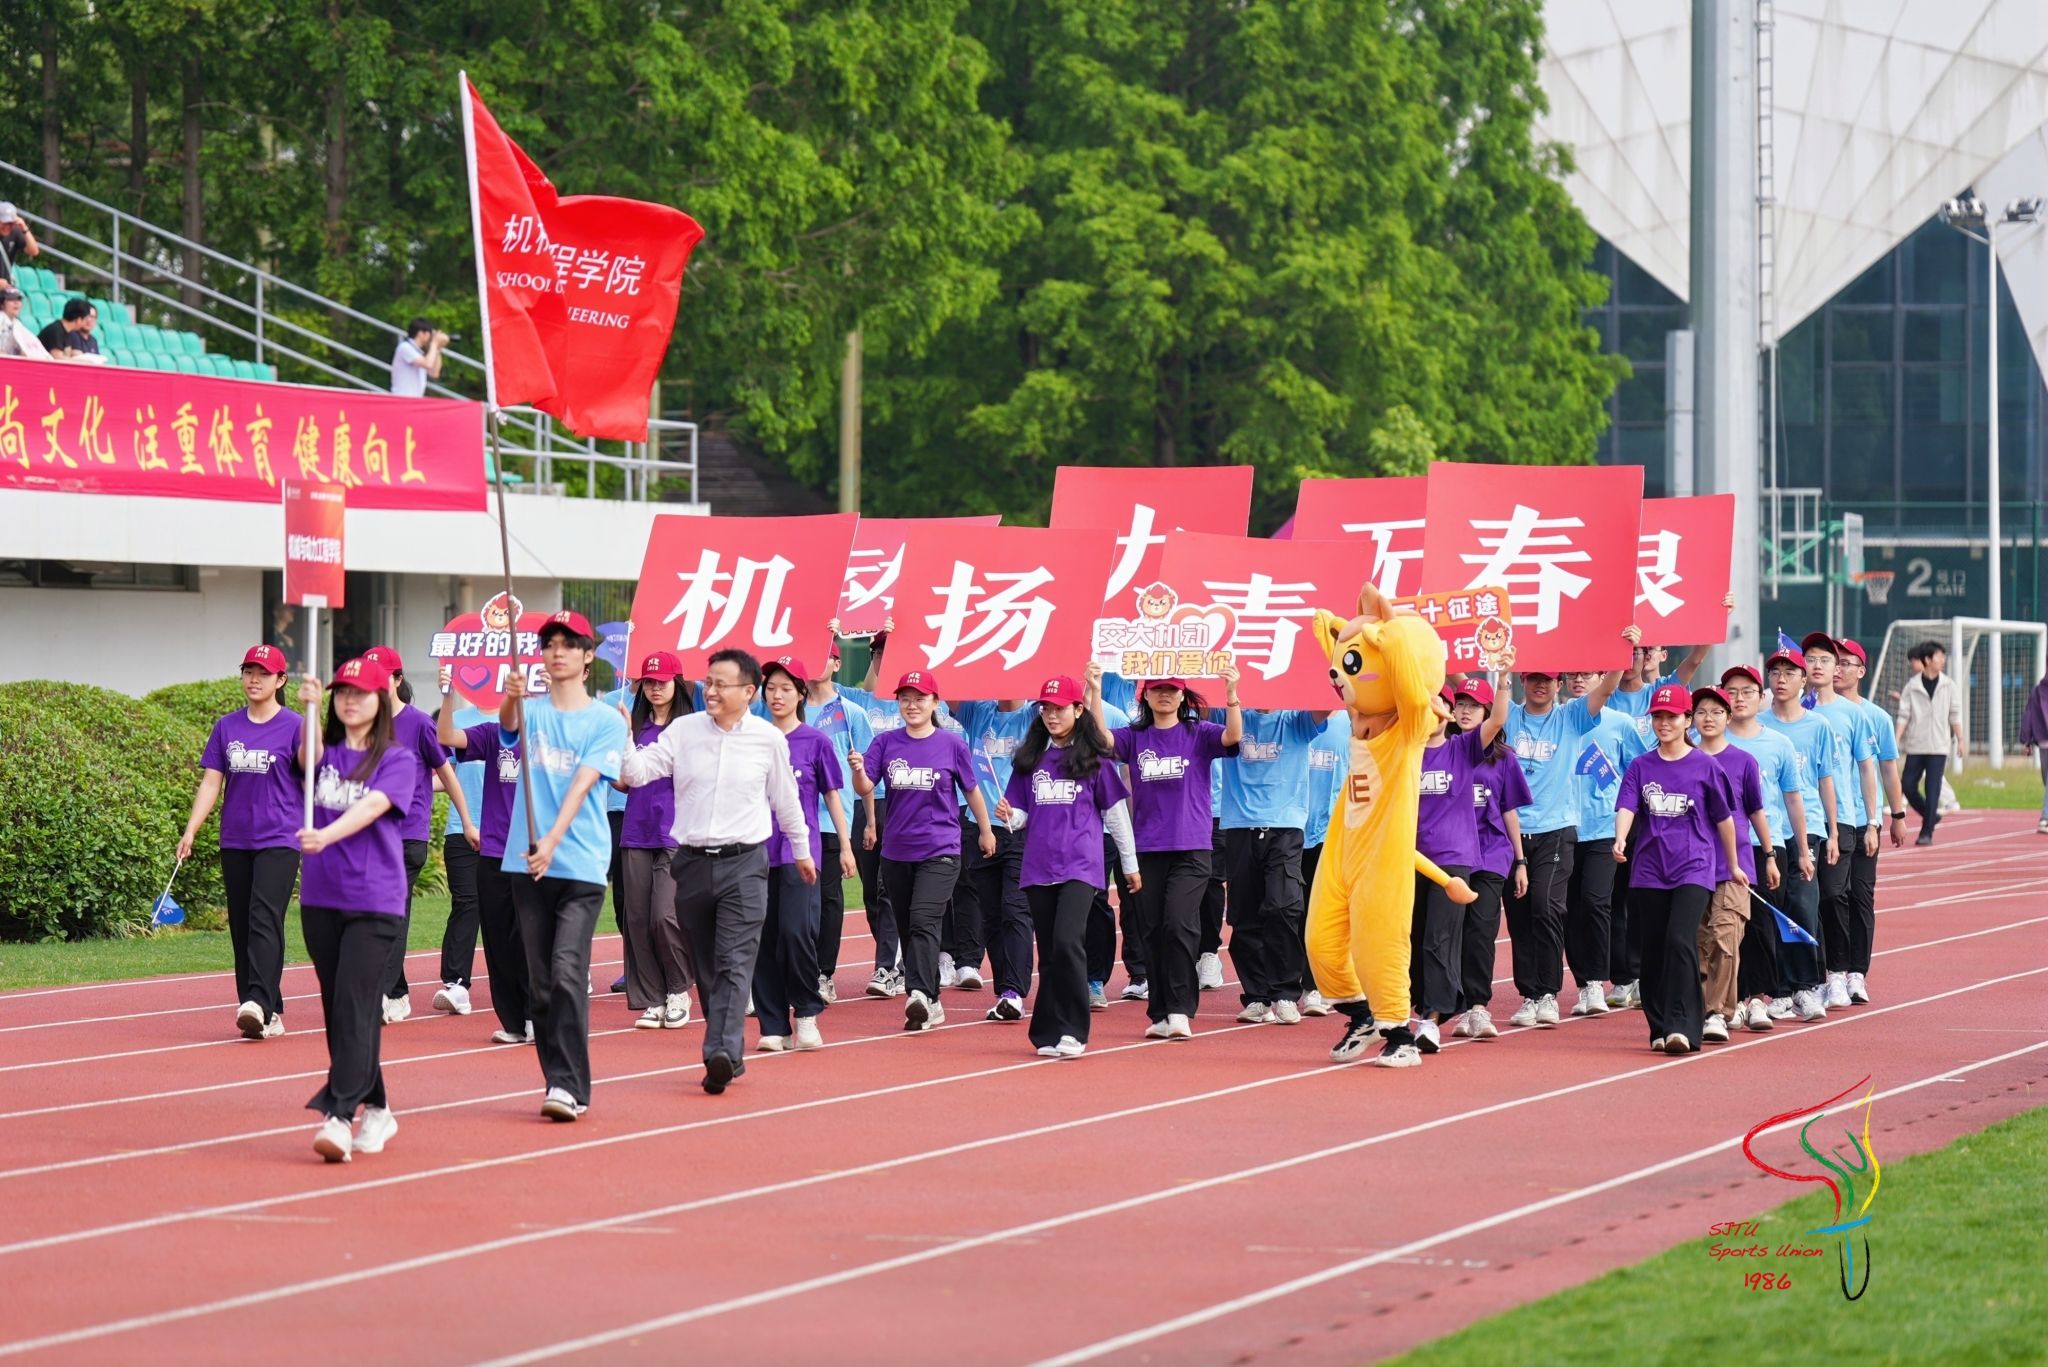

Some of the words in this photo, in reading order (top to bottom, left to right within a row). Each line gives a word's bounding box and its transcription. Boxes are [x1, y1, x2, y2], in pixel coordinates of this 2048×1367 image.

[567, 306, 630, 329] EERING
[133, 402, 275, 488] 注重体育
[293, 409, 426, 489] 健康向上
[1459, 503, 1593, 635] 春
[1907, 557, 1932, 597] 2
[661, 548, 796, 651] 机
[1391, 592, 1499, 623] 十征途
[918, 560, 1057, 671] 扬
[1202, 573, 1319, 680] 青
[430, 631, 544, 657] 最好的我
[1099, 623, 1209, 648] 交大机动
[1122, 650, 1232, 675] 我们爱你
[231, 750, 269, 769] ME
[1142, 758, 1183, 777] ME
[892, 768, 933, 786] ME
[1348, 774, 1370, 803] E
[1036, 781, 1076, 801] ME
[1650, 794, 1687, 812] ME
